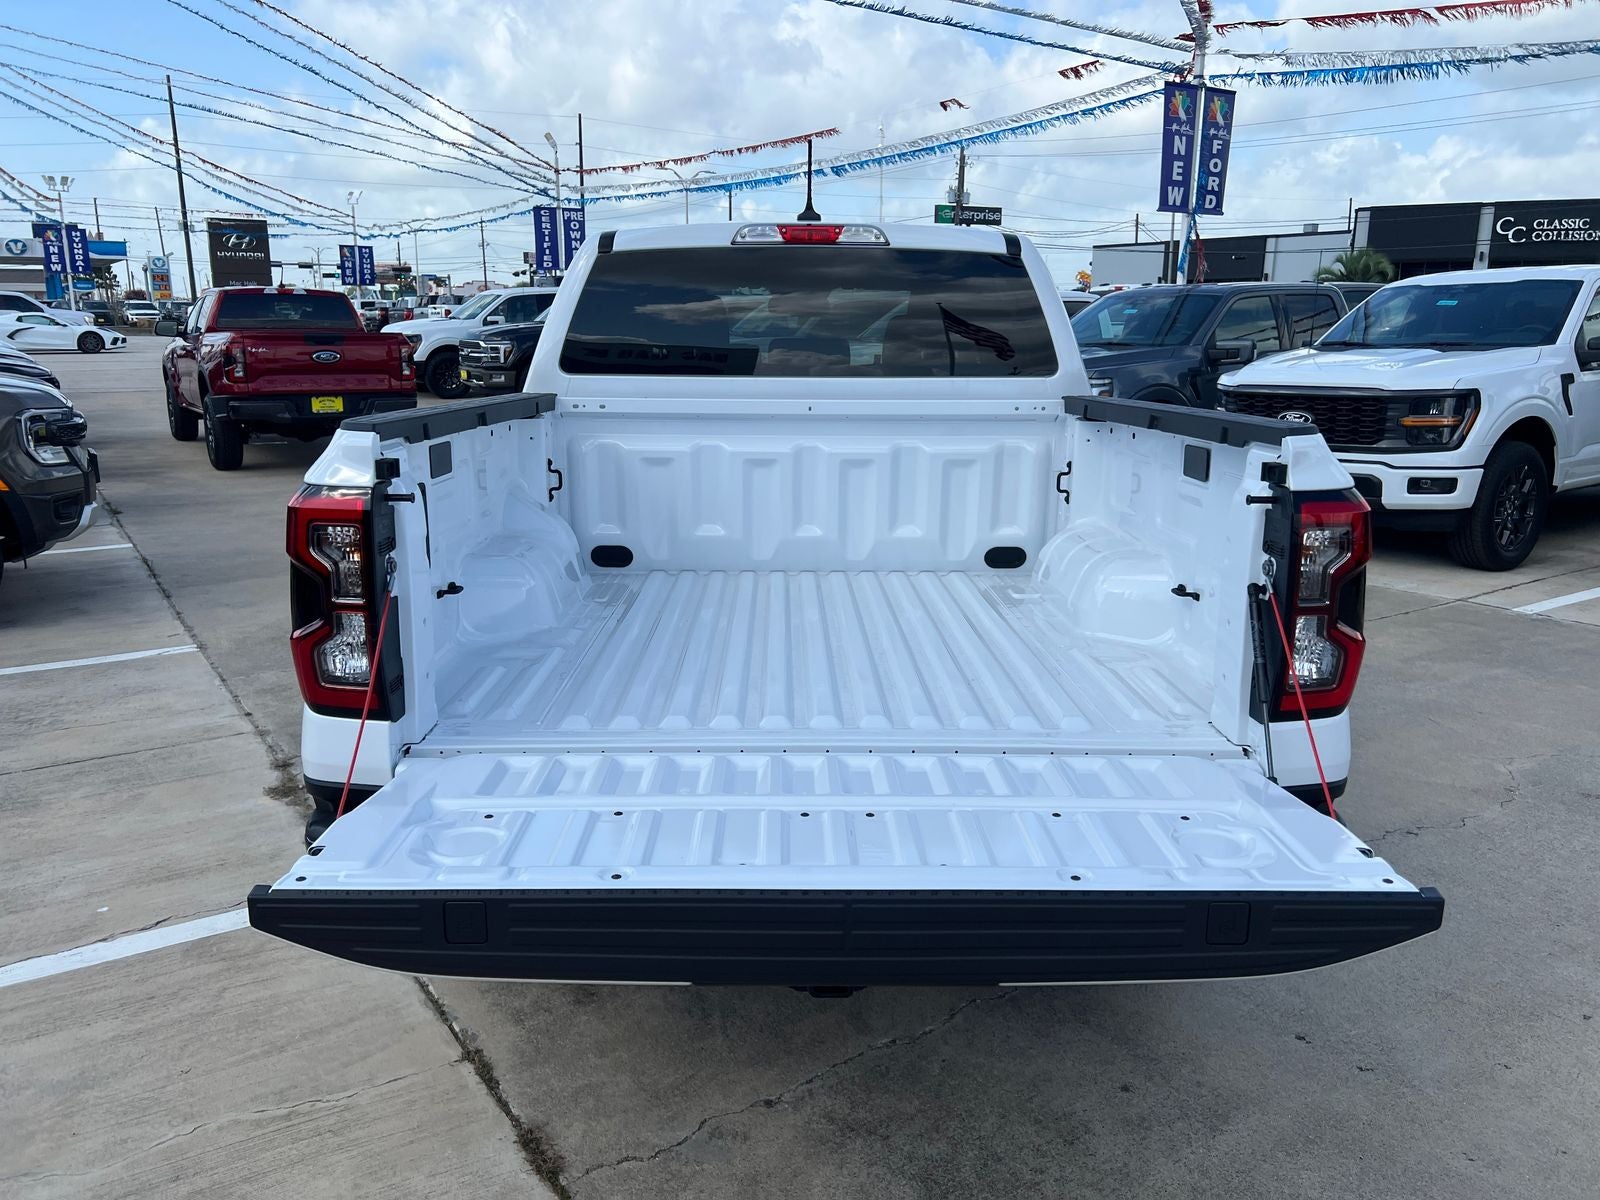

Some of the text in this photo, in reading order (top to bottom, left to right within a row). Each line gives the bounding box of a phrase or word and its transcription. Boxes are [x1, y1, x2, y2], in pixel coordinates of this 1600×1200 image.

[1168, 135, 1186, 206] NEW
[1204, 139, 1223, 209] FORD
[563, 210, 584, 221] PRE
[1533, 218, 1590, 230] CLASSIC
[71, 230, 85, 272] HYUNDAI
[217, 251, 265, 260] HYUNDAI
[540, 209, 553, 268] CERTIFIED
[569, 221, 581, 258] OWN
[49, 245, 62, 272] NEW
[344, 260, 354, 284] NEW
[362, 248, 372, 284] HYUNDAI
